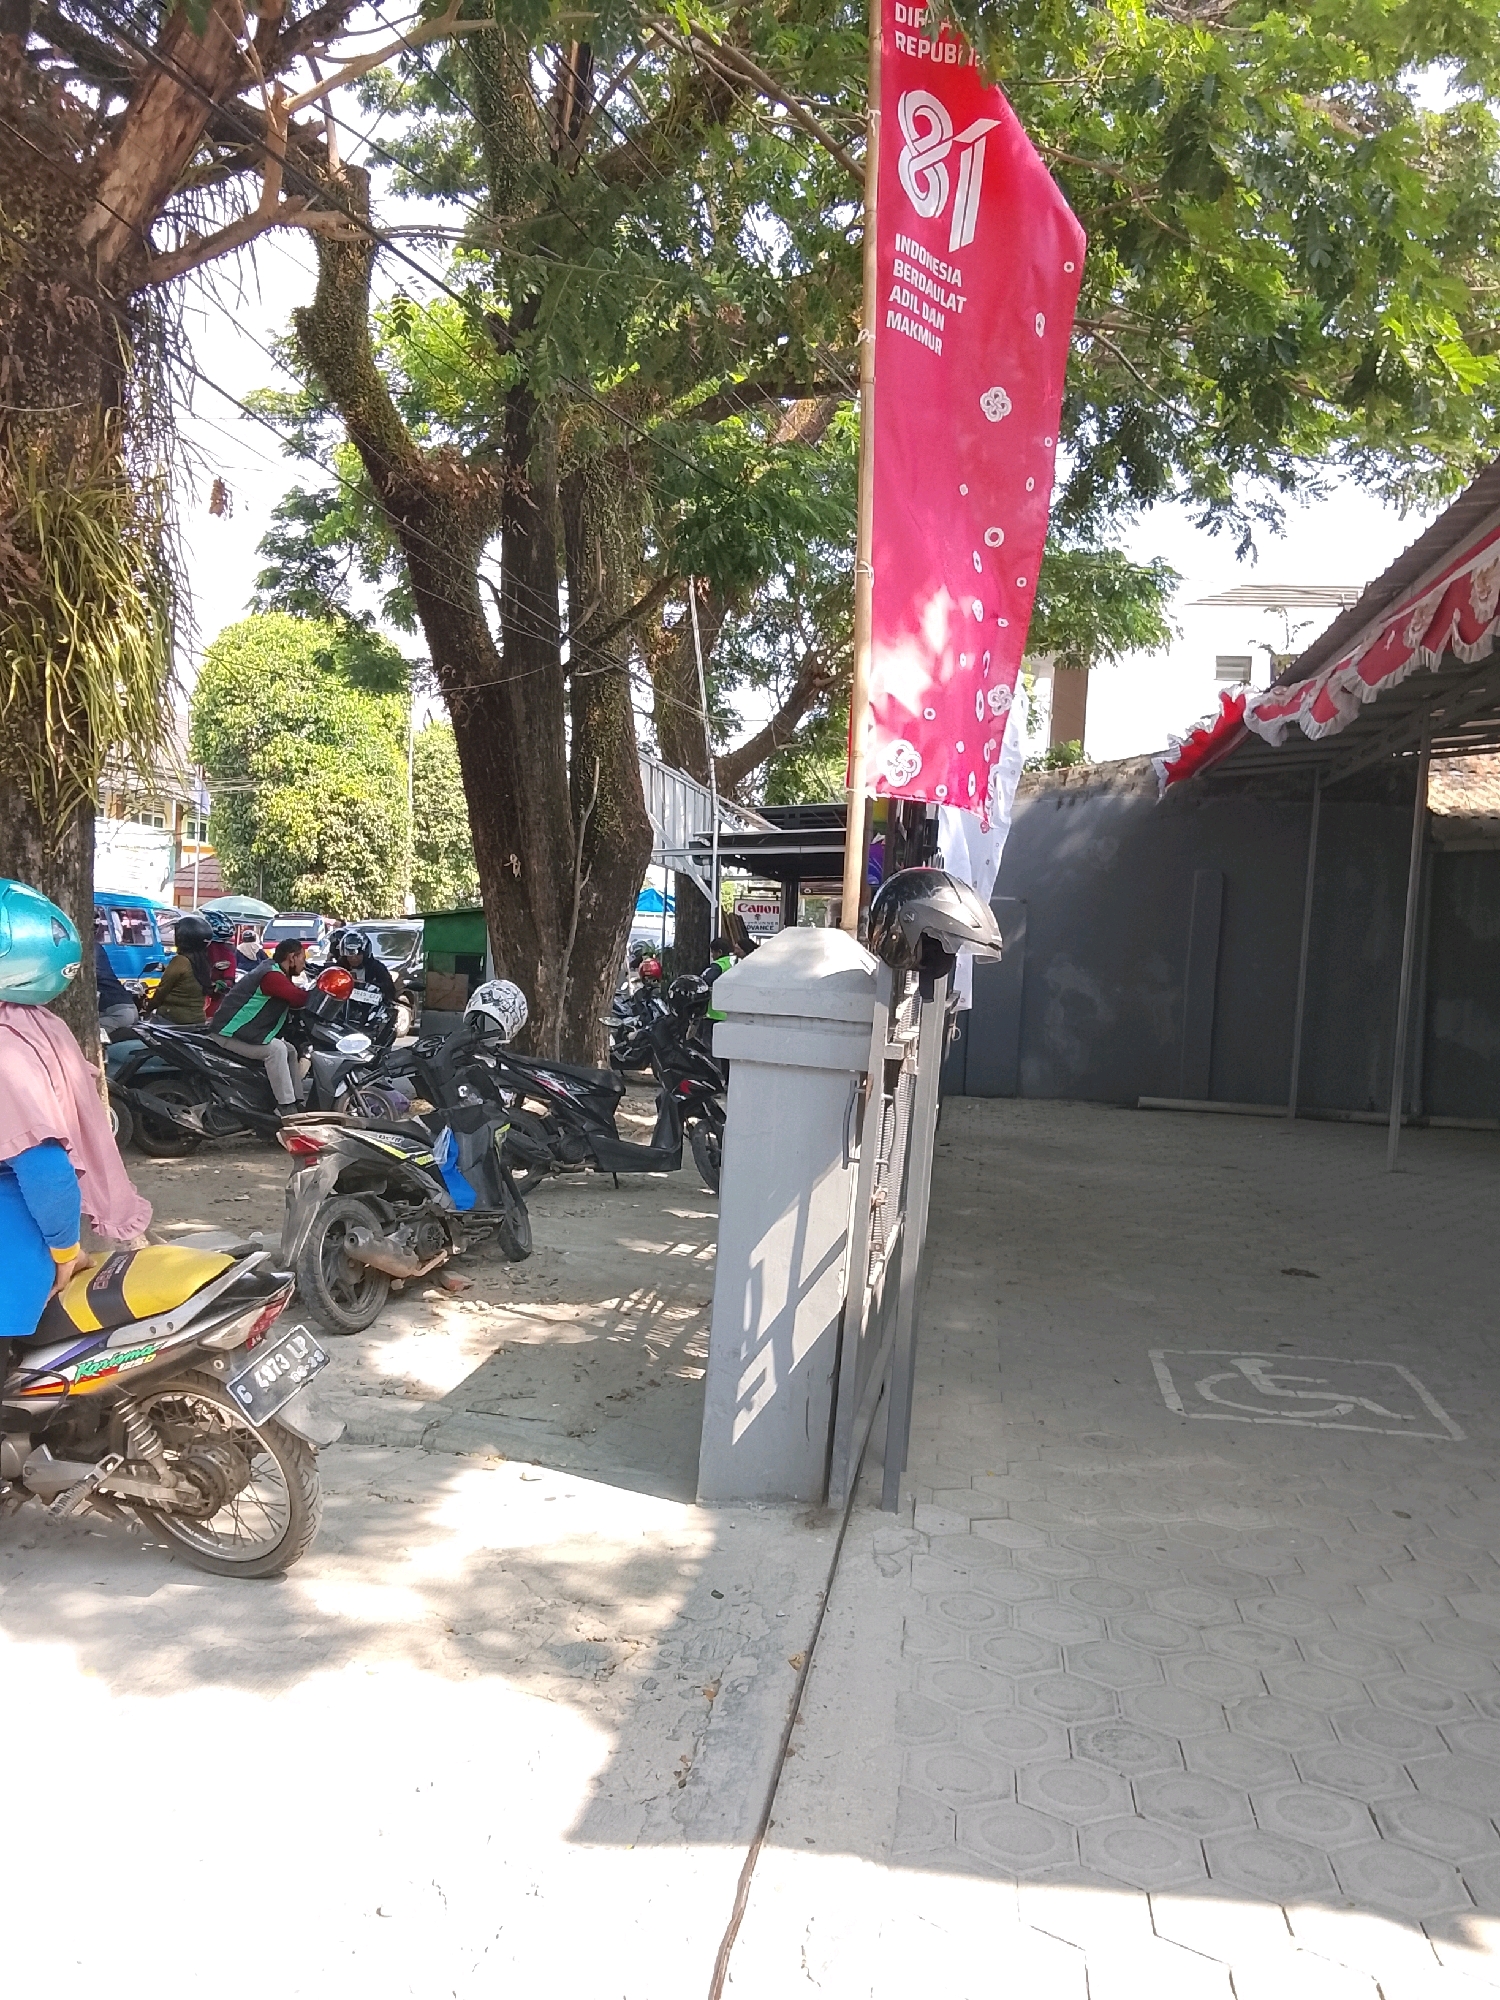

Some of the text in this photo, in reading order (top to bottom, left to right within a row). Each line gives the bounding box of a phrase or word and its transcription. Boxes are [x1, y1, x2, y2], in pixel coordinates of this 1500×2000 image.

[898, 89, 1002, 253] 81
[895, 232, 962, 288] INDONESIA
[888, 285, 945, 332] ADIL DAN
[892, 258, 968, 314] BERDAULAT
[886, 310, 943, 357] MAKMUR
[738, 903, 779, 914] Canon
[285, 1335, 309, 1359] LP
